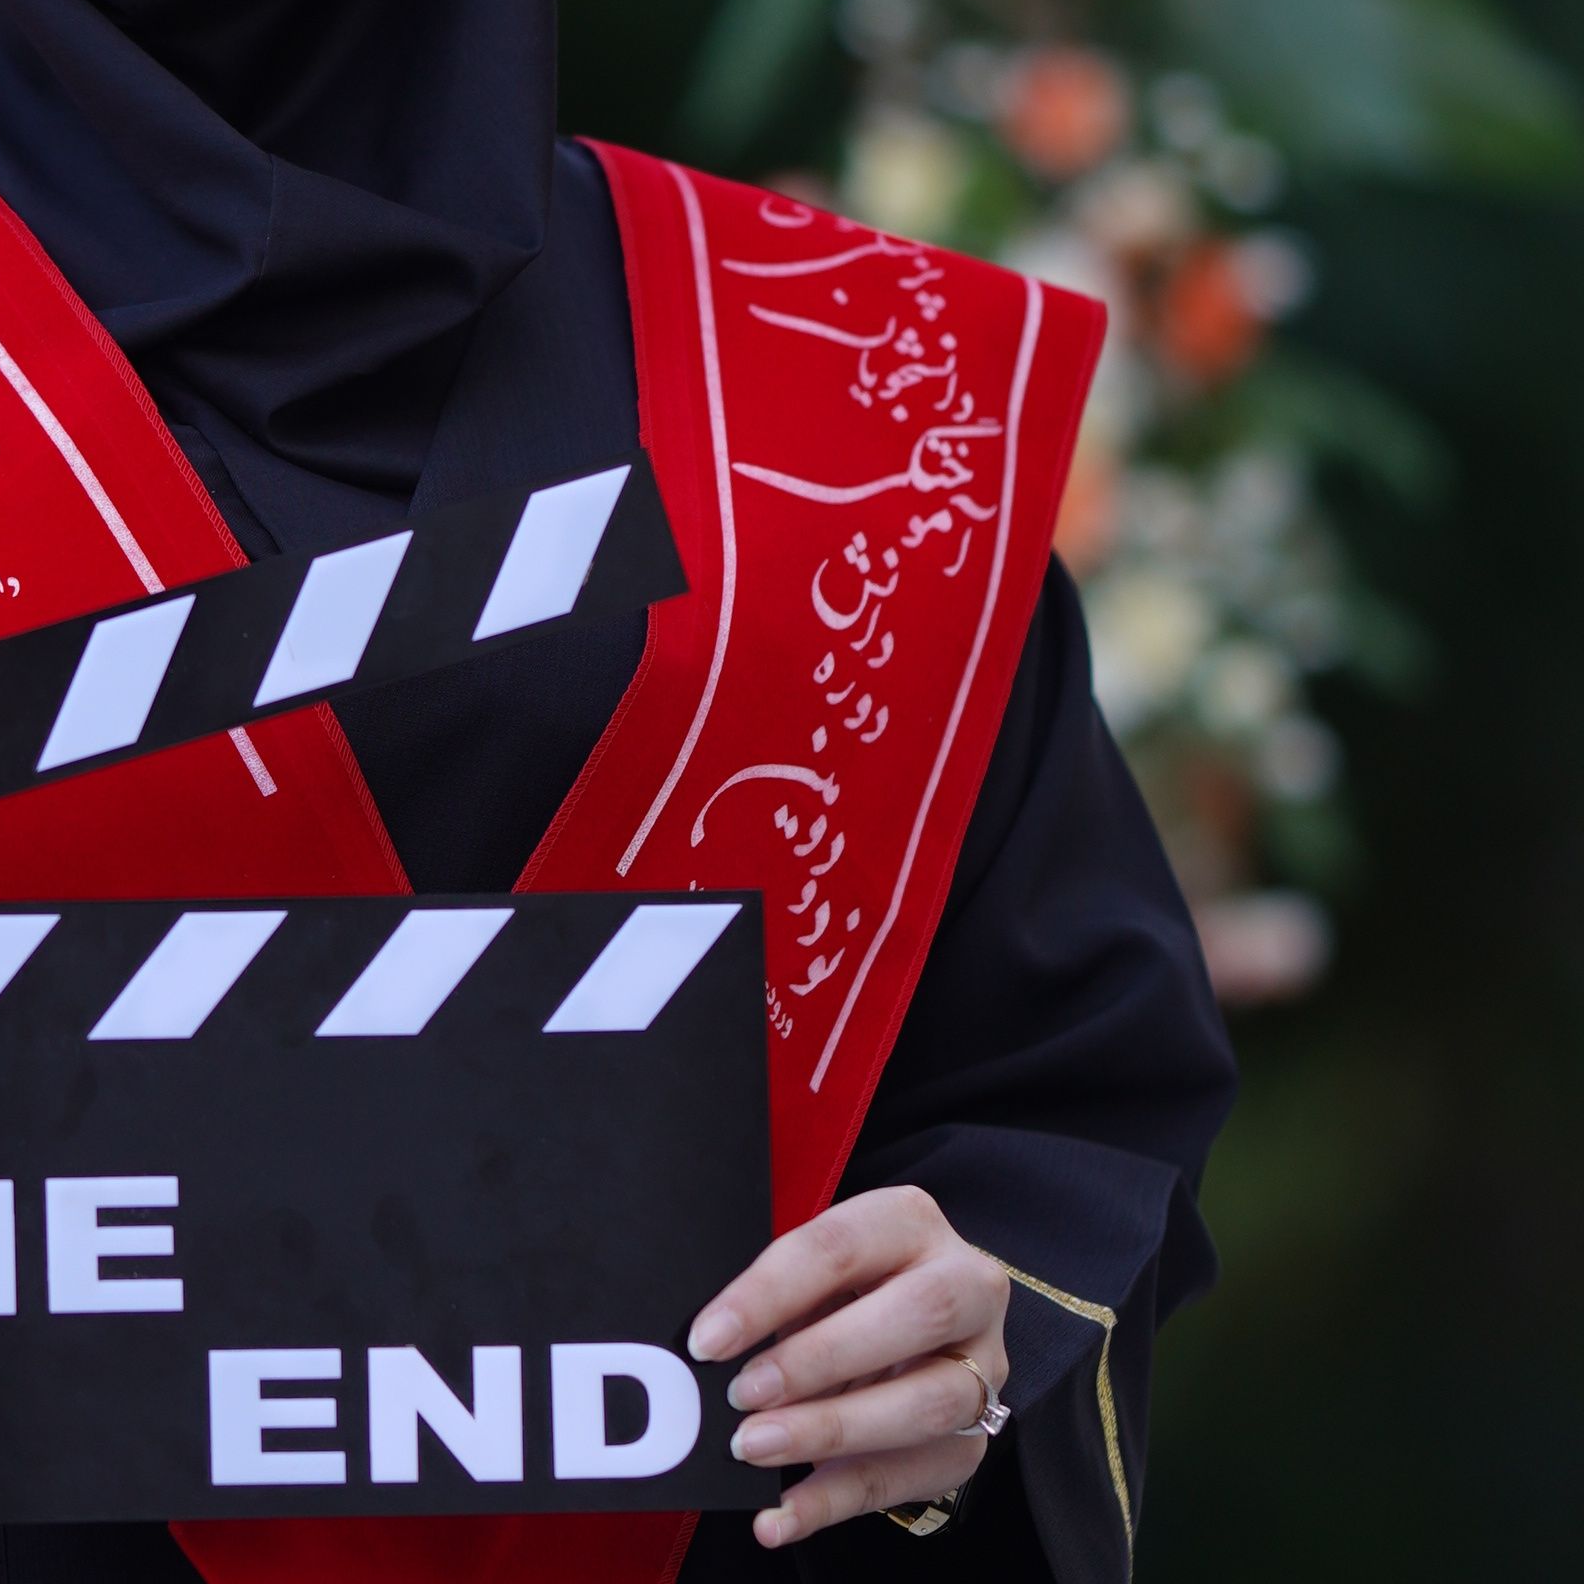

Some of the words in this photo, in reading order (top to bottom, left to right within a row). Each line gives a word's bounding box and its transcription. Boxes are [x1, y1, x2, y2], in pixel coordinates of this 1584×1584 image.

[747, 287, 975, 424] دانشجویان
[813, 651, 889, 744] دوره
[209, 1343, 702, 1486] END
